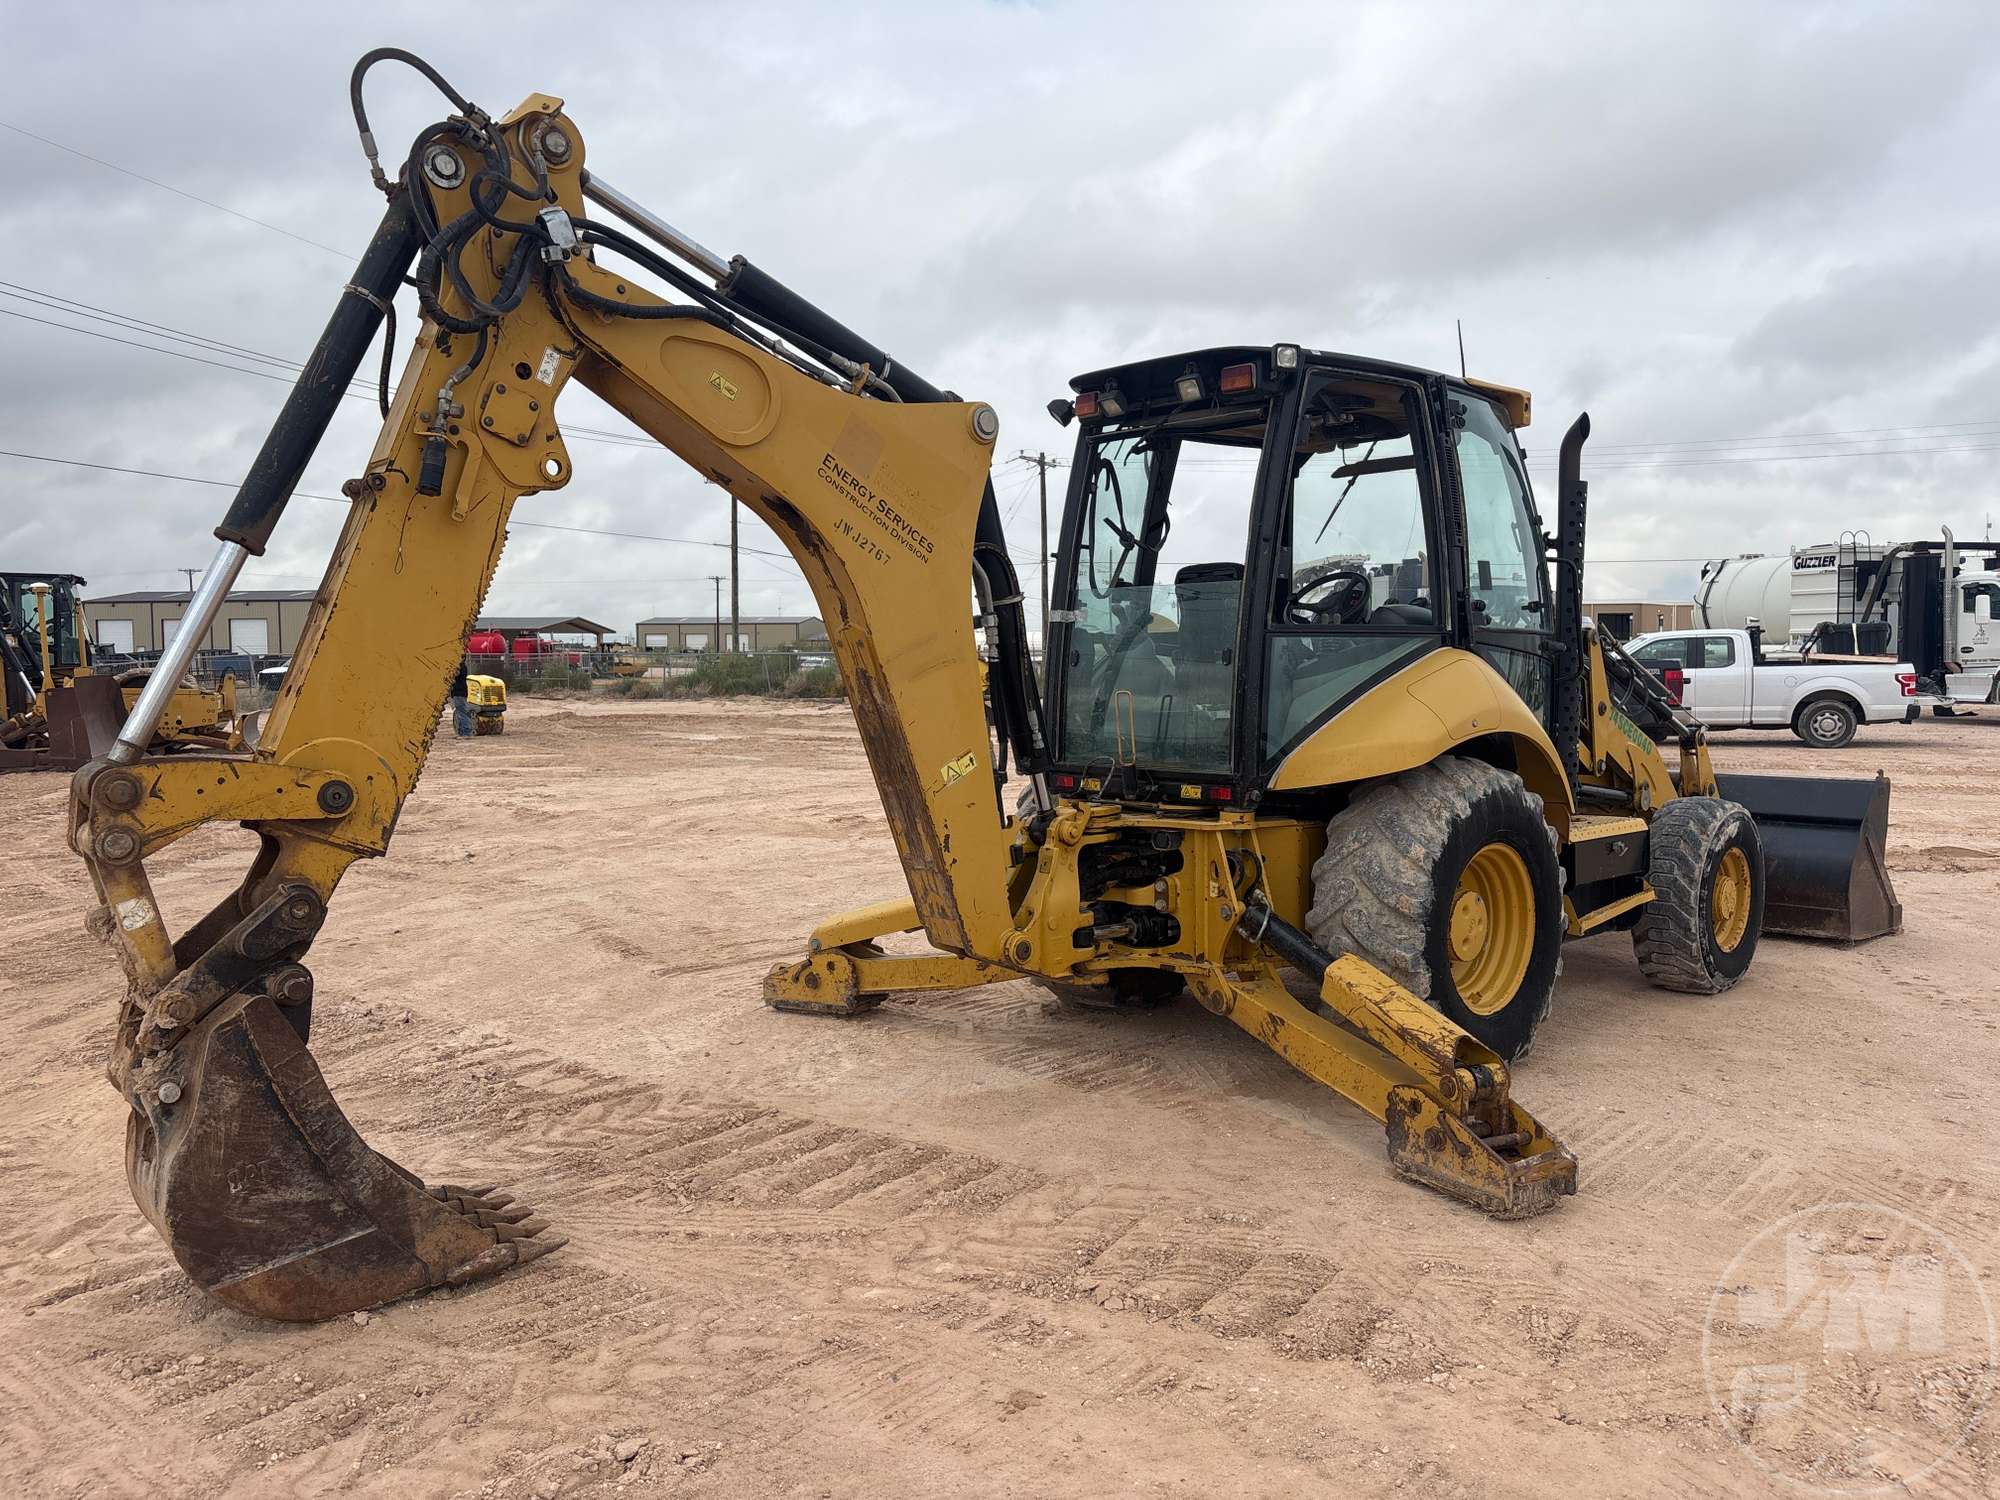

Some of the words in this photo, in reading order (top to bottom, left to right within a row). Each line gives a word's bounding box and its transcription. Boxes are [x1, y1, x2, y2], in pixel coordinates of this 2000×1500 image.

[817, 467, 890, 531] CONSTRUCTION
[890, 528, 929, 564] DIVISION
[822, 452, 876, 503] ENERGY
[876, 499, 935, 554] SERVICES
[1794, 555, 1837, 569] GUZZLER
